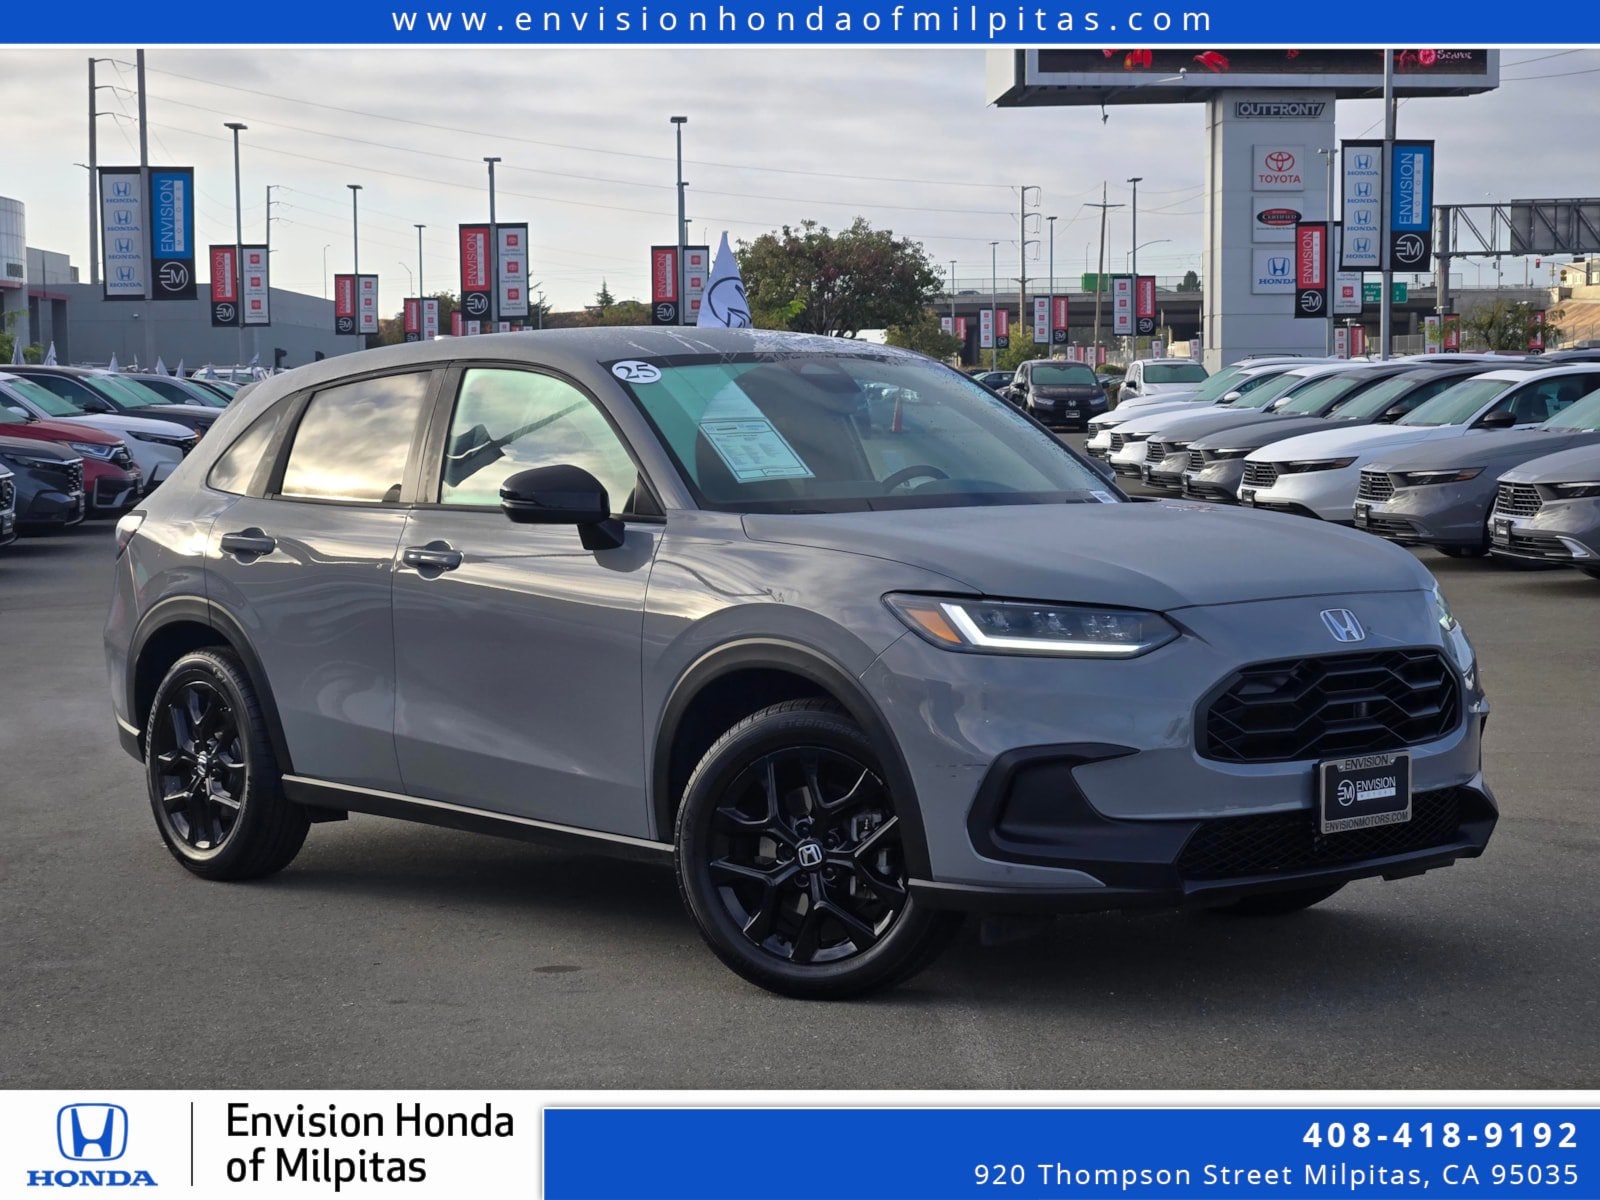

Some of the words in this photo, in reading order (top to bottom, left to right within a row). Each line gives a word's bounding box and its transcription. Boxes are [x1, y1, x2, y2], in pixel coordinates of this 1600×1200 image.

[1258, 174, 1301, 184] TOYOTA
[1399, 153, 1414, 225] ENVISION
[160, 180, 174, 252] ENVISION
[467, 233, 478, 287] ENVISION
[1303, 231, 1313, 284] ENVISION
[215, 253, 225, 298] ENVISION
[616, 363, 657, 380] 25
[1345, 754, 1389, 770] ENVISION
[1356, 776, 1396, 792] ENVISION
[1325, 811, 1408, 830] ENVISIONMOTORS.COM
